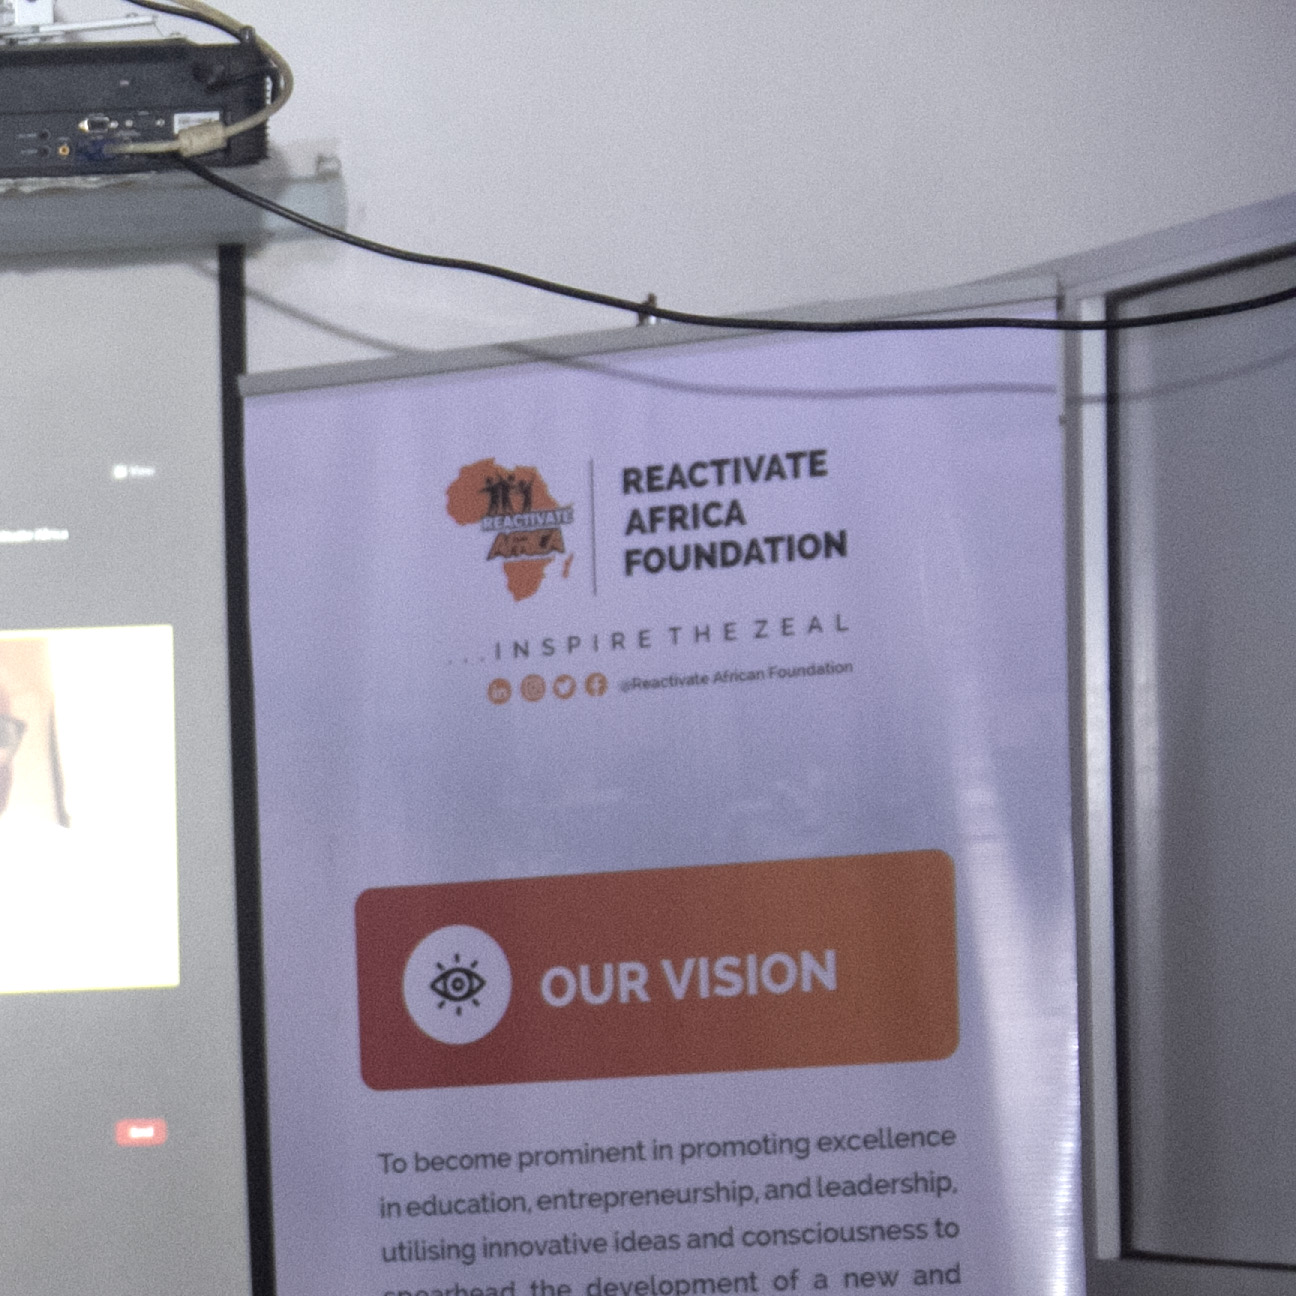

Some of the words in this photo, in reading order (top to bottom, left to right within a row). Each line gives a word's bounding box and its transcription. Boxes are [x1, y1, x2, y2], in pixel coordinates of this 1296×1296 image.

[622, 449, 829, 495] REACTIVATE
[623, 499, 747, 536] AFRICA
[624, 529, 848, 577] FOUNDATION
[713, 668, 765, 684] African
[767, 661, 854, 680] Foundation
[540, 960, 651, 1008] OUR
[661, 949, 838, 1001] VISION
[378, 1152, 407, 1175] To
[414, 1150, 512, 1173] become
[517, 1140, 647, 1173] prominent
[652, 1139, 675, 1162] in
[680, 1133, 811, 1165] promoting
[816, 1127, 958, 1152] excellence
[379, 1196, 402, 1219] in
[764, 1176, 812, 1200] and
[382, 1238, 477, 1266] utilising
[482, 1232, 609, 1259] innovative
[613, 1229, 681, 1252] ideas
[686, 1225, 735, 1250] and
[741, 1221, 929, 1248] consciousness
[933, 1217, 960, 1240] to
[772, 1267, 801, 1292] of
[812, 1272, 829, 1290] a
[843, 1269, 900, 1289] new
[912, 1261, 962, 1287] and
